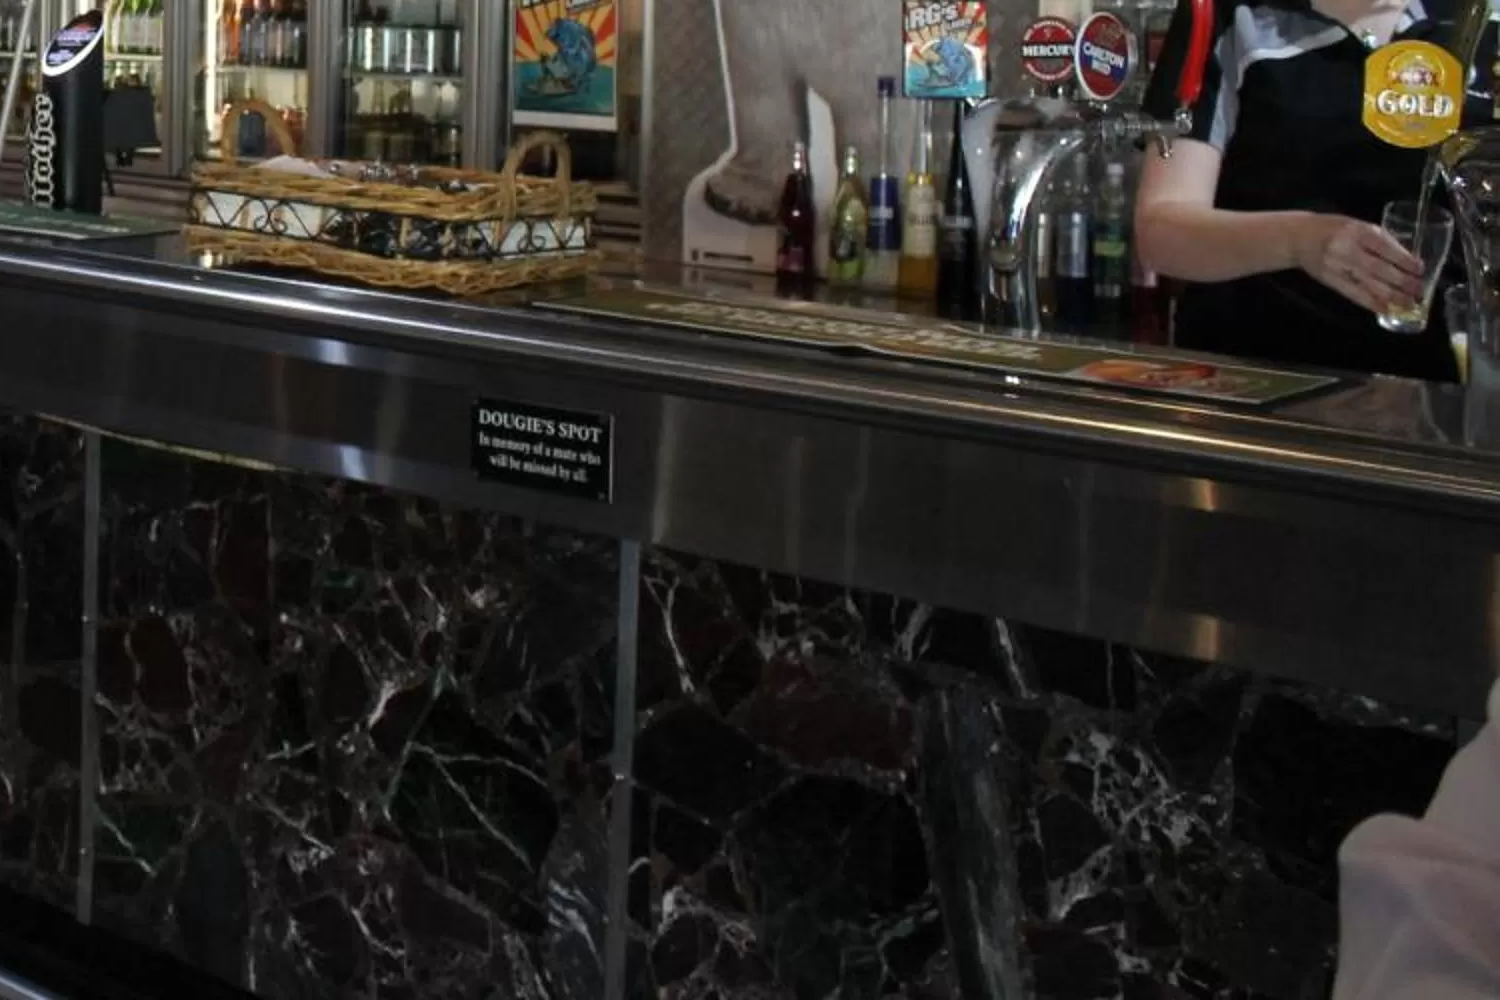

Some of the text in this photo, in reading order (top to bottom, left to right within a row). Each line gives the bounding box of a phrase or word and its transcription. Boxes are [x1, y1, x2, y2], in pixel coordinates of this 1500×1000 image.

[1377, 88, 1455, 117] GOLD
[478, 408, 603, 444] DOUGIE'S SPOT
